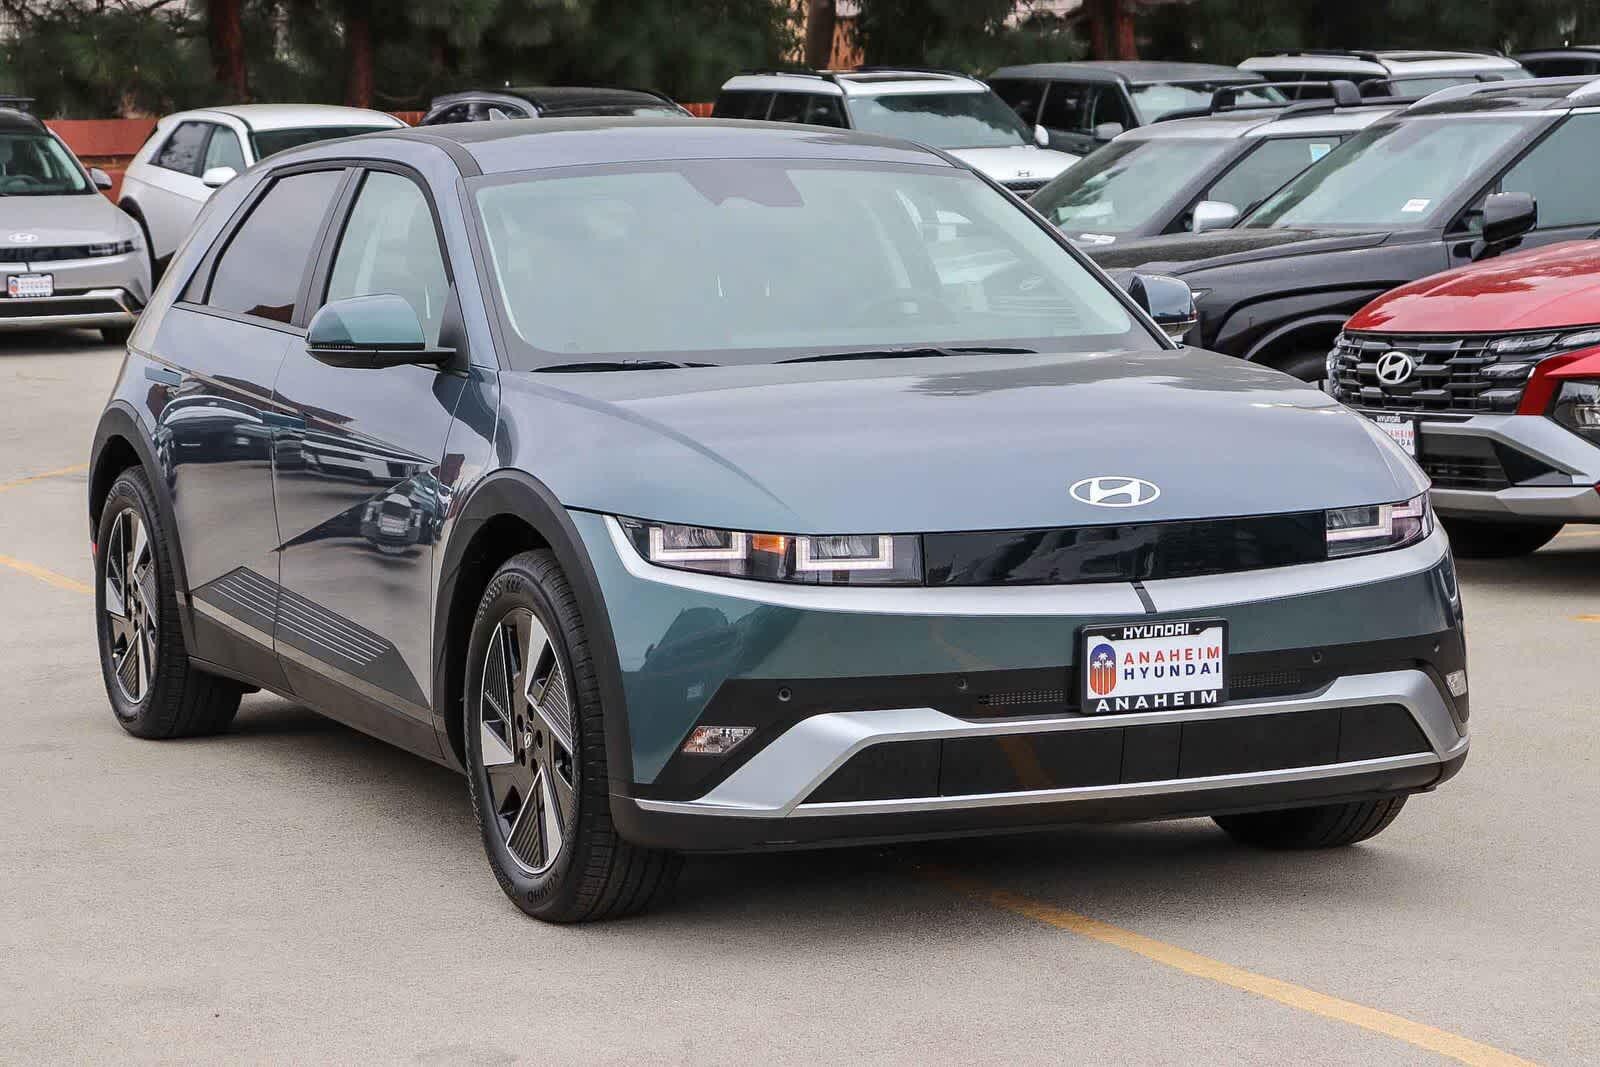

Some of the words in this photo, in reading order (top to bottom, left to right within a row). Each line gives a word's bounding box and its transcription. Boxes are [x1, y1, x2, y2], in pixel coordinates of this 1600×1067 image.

[1123, 623, 1190, 640] HYUNDAI
[1124, 646, 1220, 665] ANAHEIM
[1124, 662, 1220, 680] HYUNDAI
[1096, 690, 1217, 713] ANAHEIM
